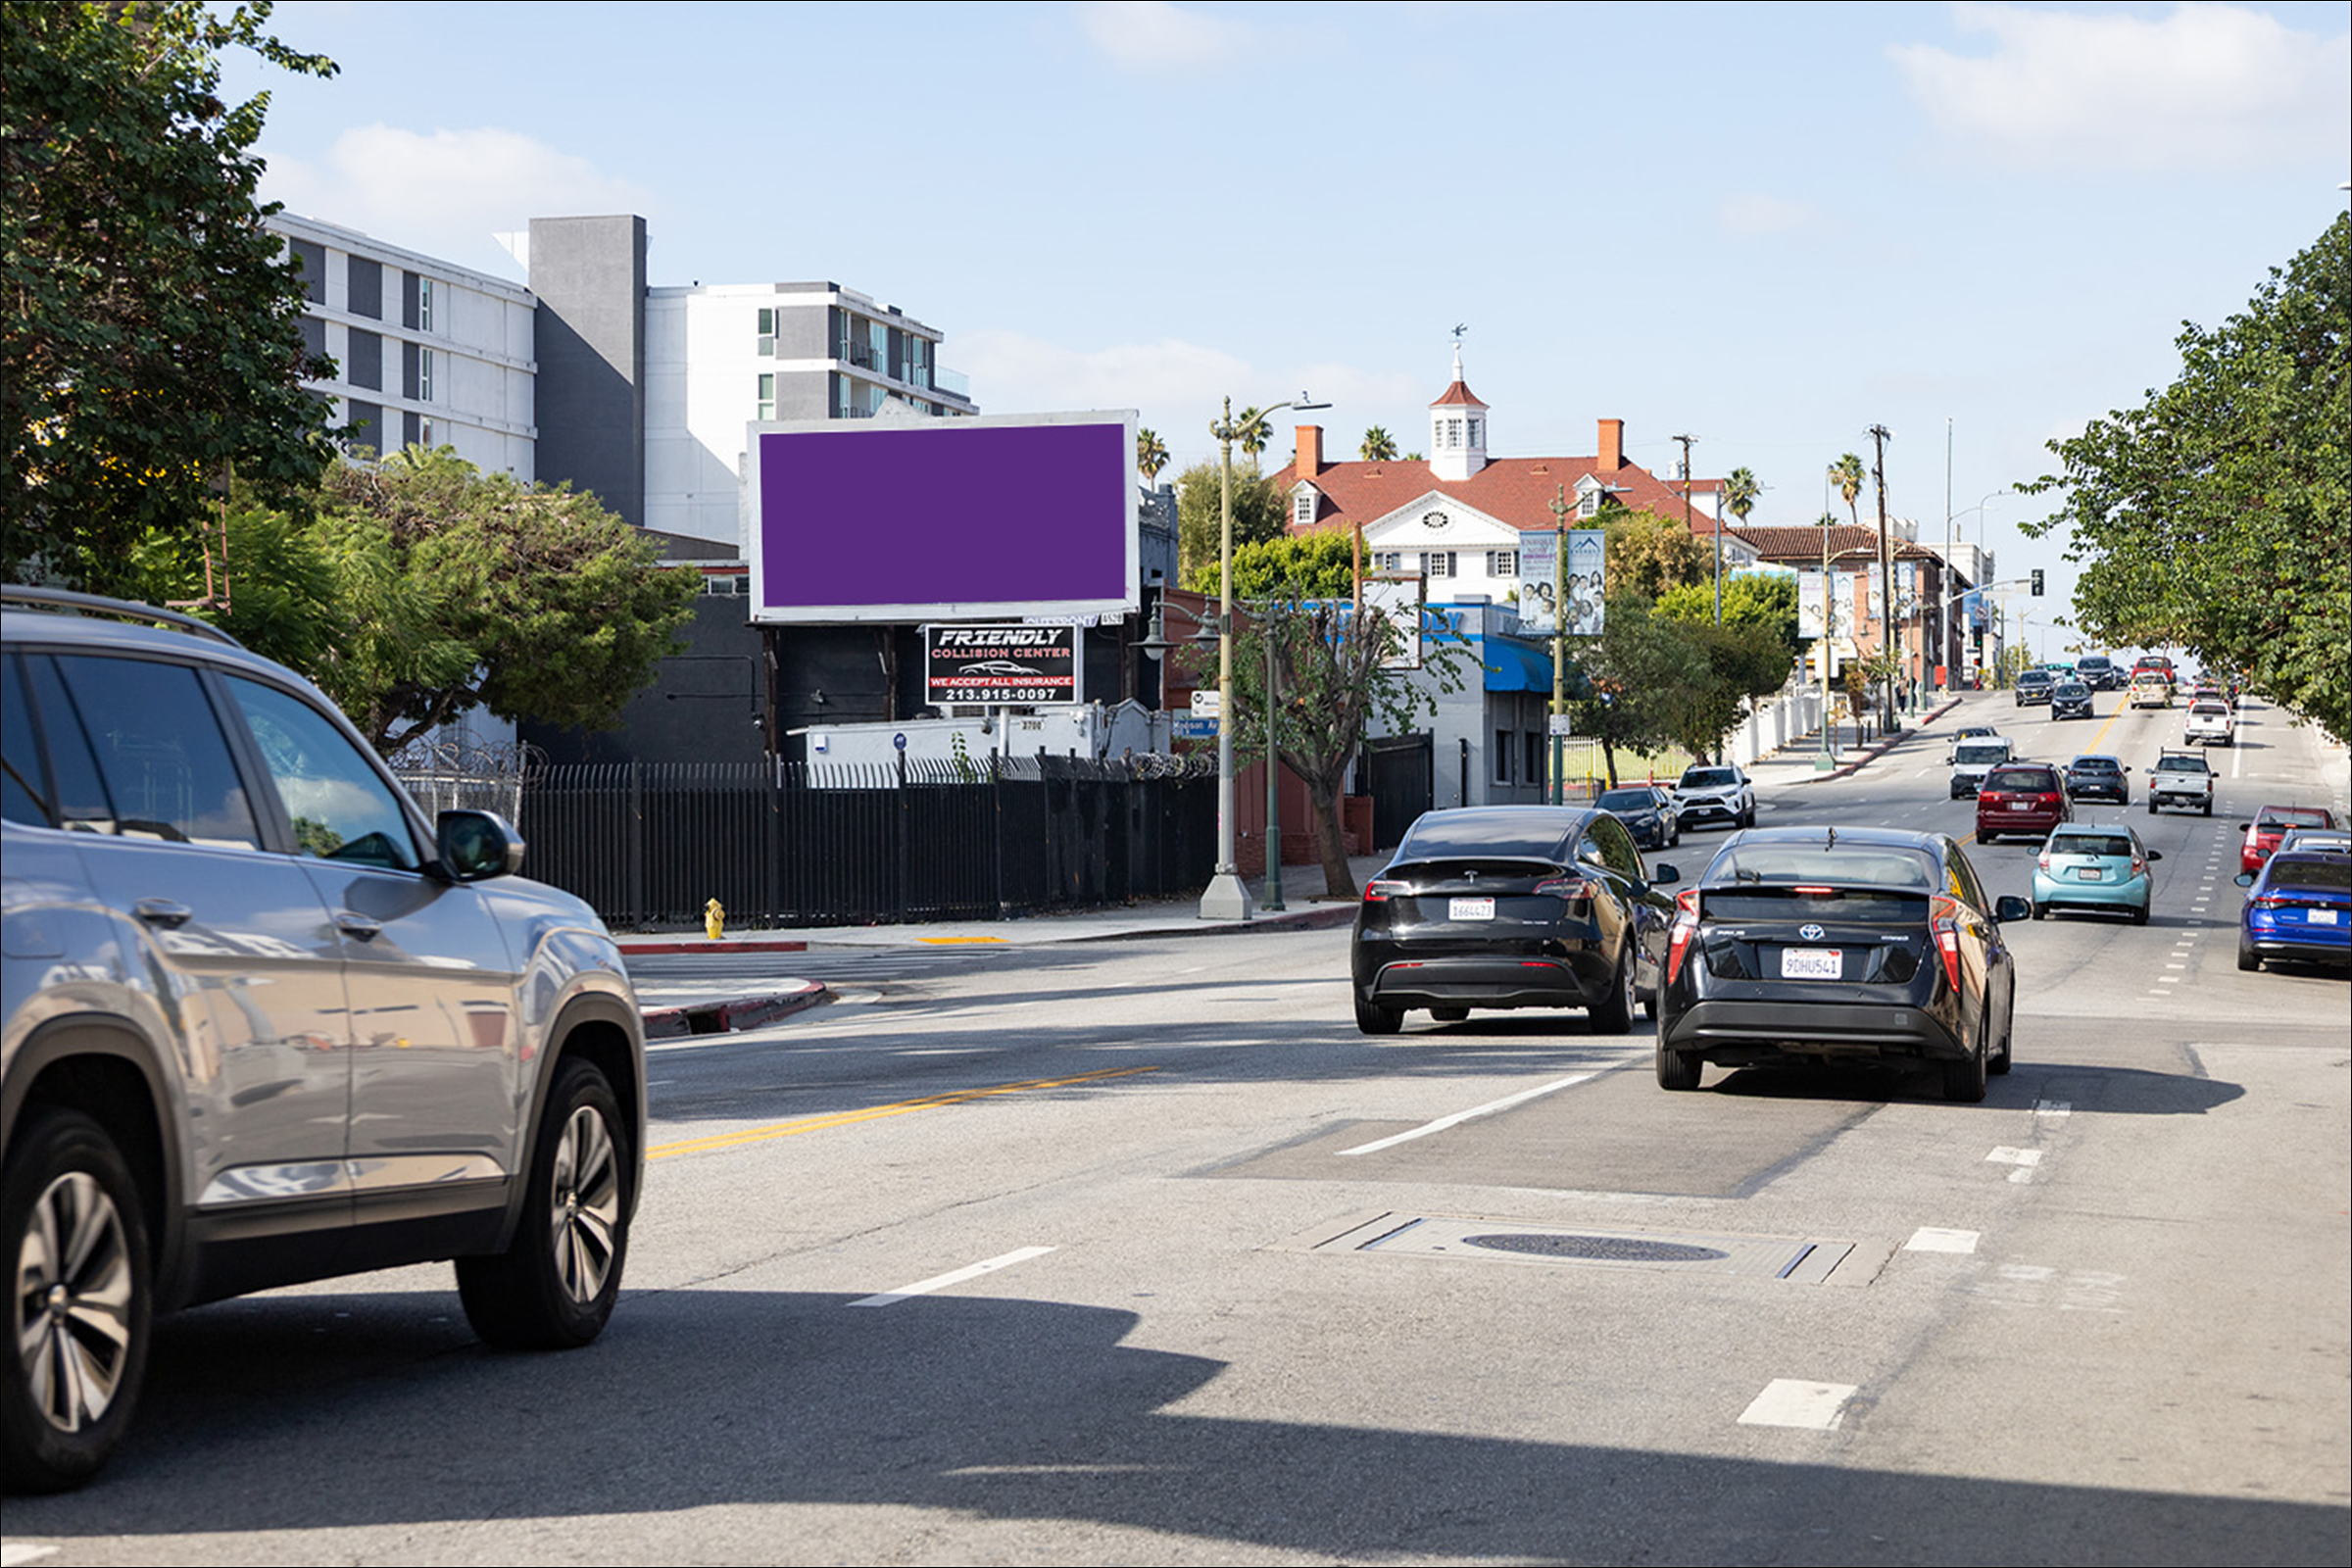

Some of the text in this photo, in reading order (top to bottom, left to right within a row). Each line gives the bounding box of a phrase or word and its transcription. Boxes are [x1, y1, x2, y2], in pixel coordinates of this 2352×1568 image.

[938, 629, 1064, 646] FRIENDLY
[931, 647, 1071, 659] COLLISION CENTER
[931, 676, 1072, 687] WE ACCEPT ALL INSURANCE
[946, 689, 1056, 701] 213.915-0097
